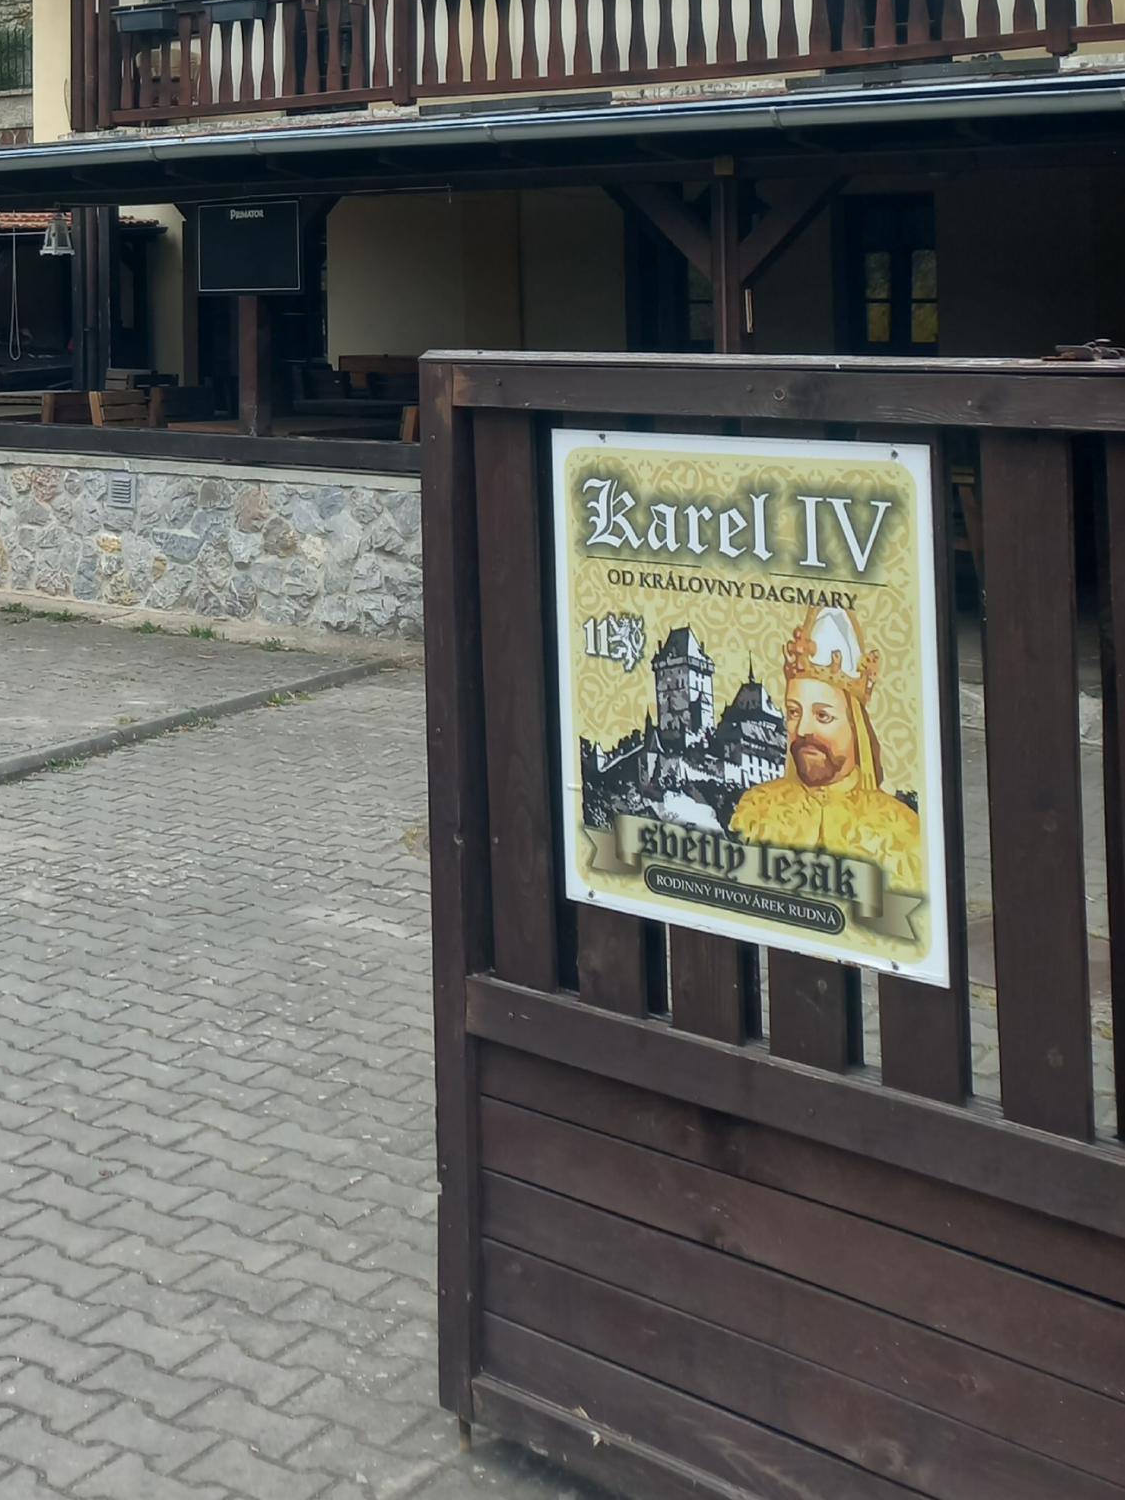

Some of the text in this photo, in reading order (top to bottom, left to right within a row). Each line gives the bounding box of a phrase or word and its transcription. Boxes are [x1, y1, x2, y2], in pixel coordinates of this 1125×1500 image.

[583, 478, 892, 572] Karel IV
[607, 569, 857, 610] OD KRÁLOVNY DAGMARY
[584, 618, 610, 656] 11
[640, 822, 859, 900] světlý ležák
[656, 874, 837, 926] RODINNÝ PIVOVÁREK RUDNÁ
